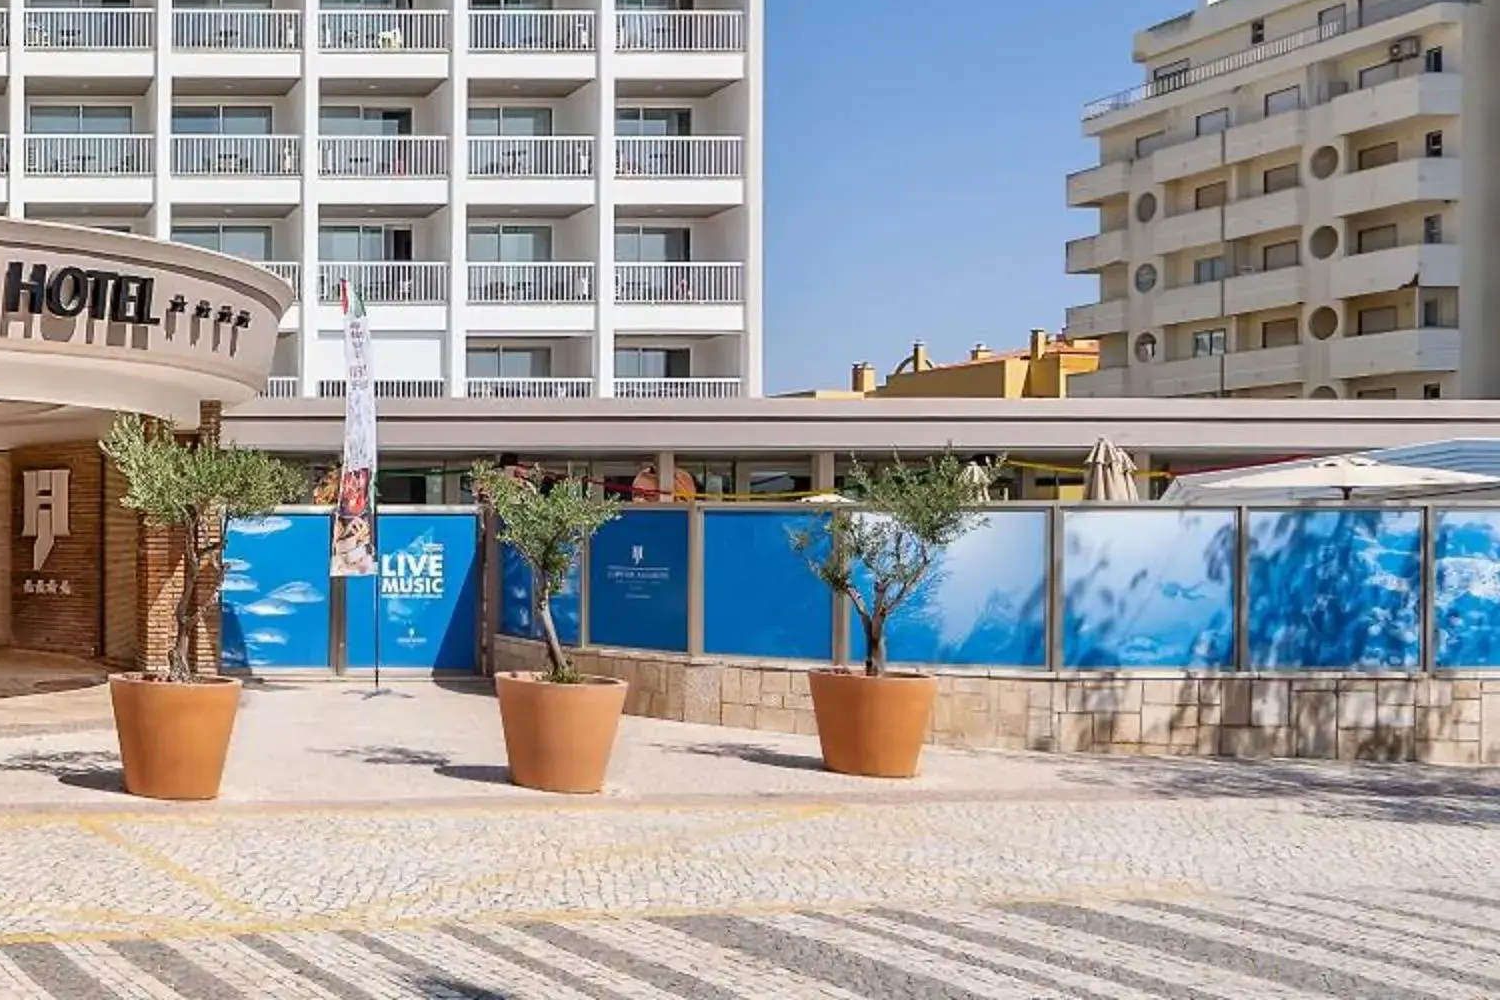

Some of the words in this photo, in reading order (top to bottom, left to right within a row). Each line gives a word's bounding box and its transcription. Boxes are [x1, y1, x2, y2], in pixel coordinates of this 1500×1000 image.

[6, 261, 160, 325] HOTEL
[381, 553, 444, 577] LIVE
[381, 578, 444, 593] MUSIC
